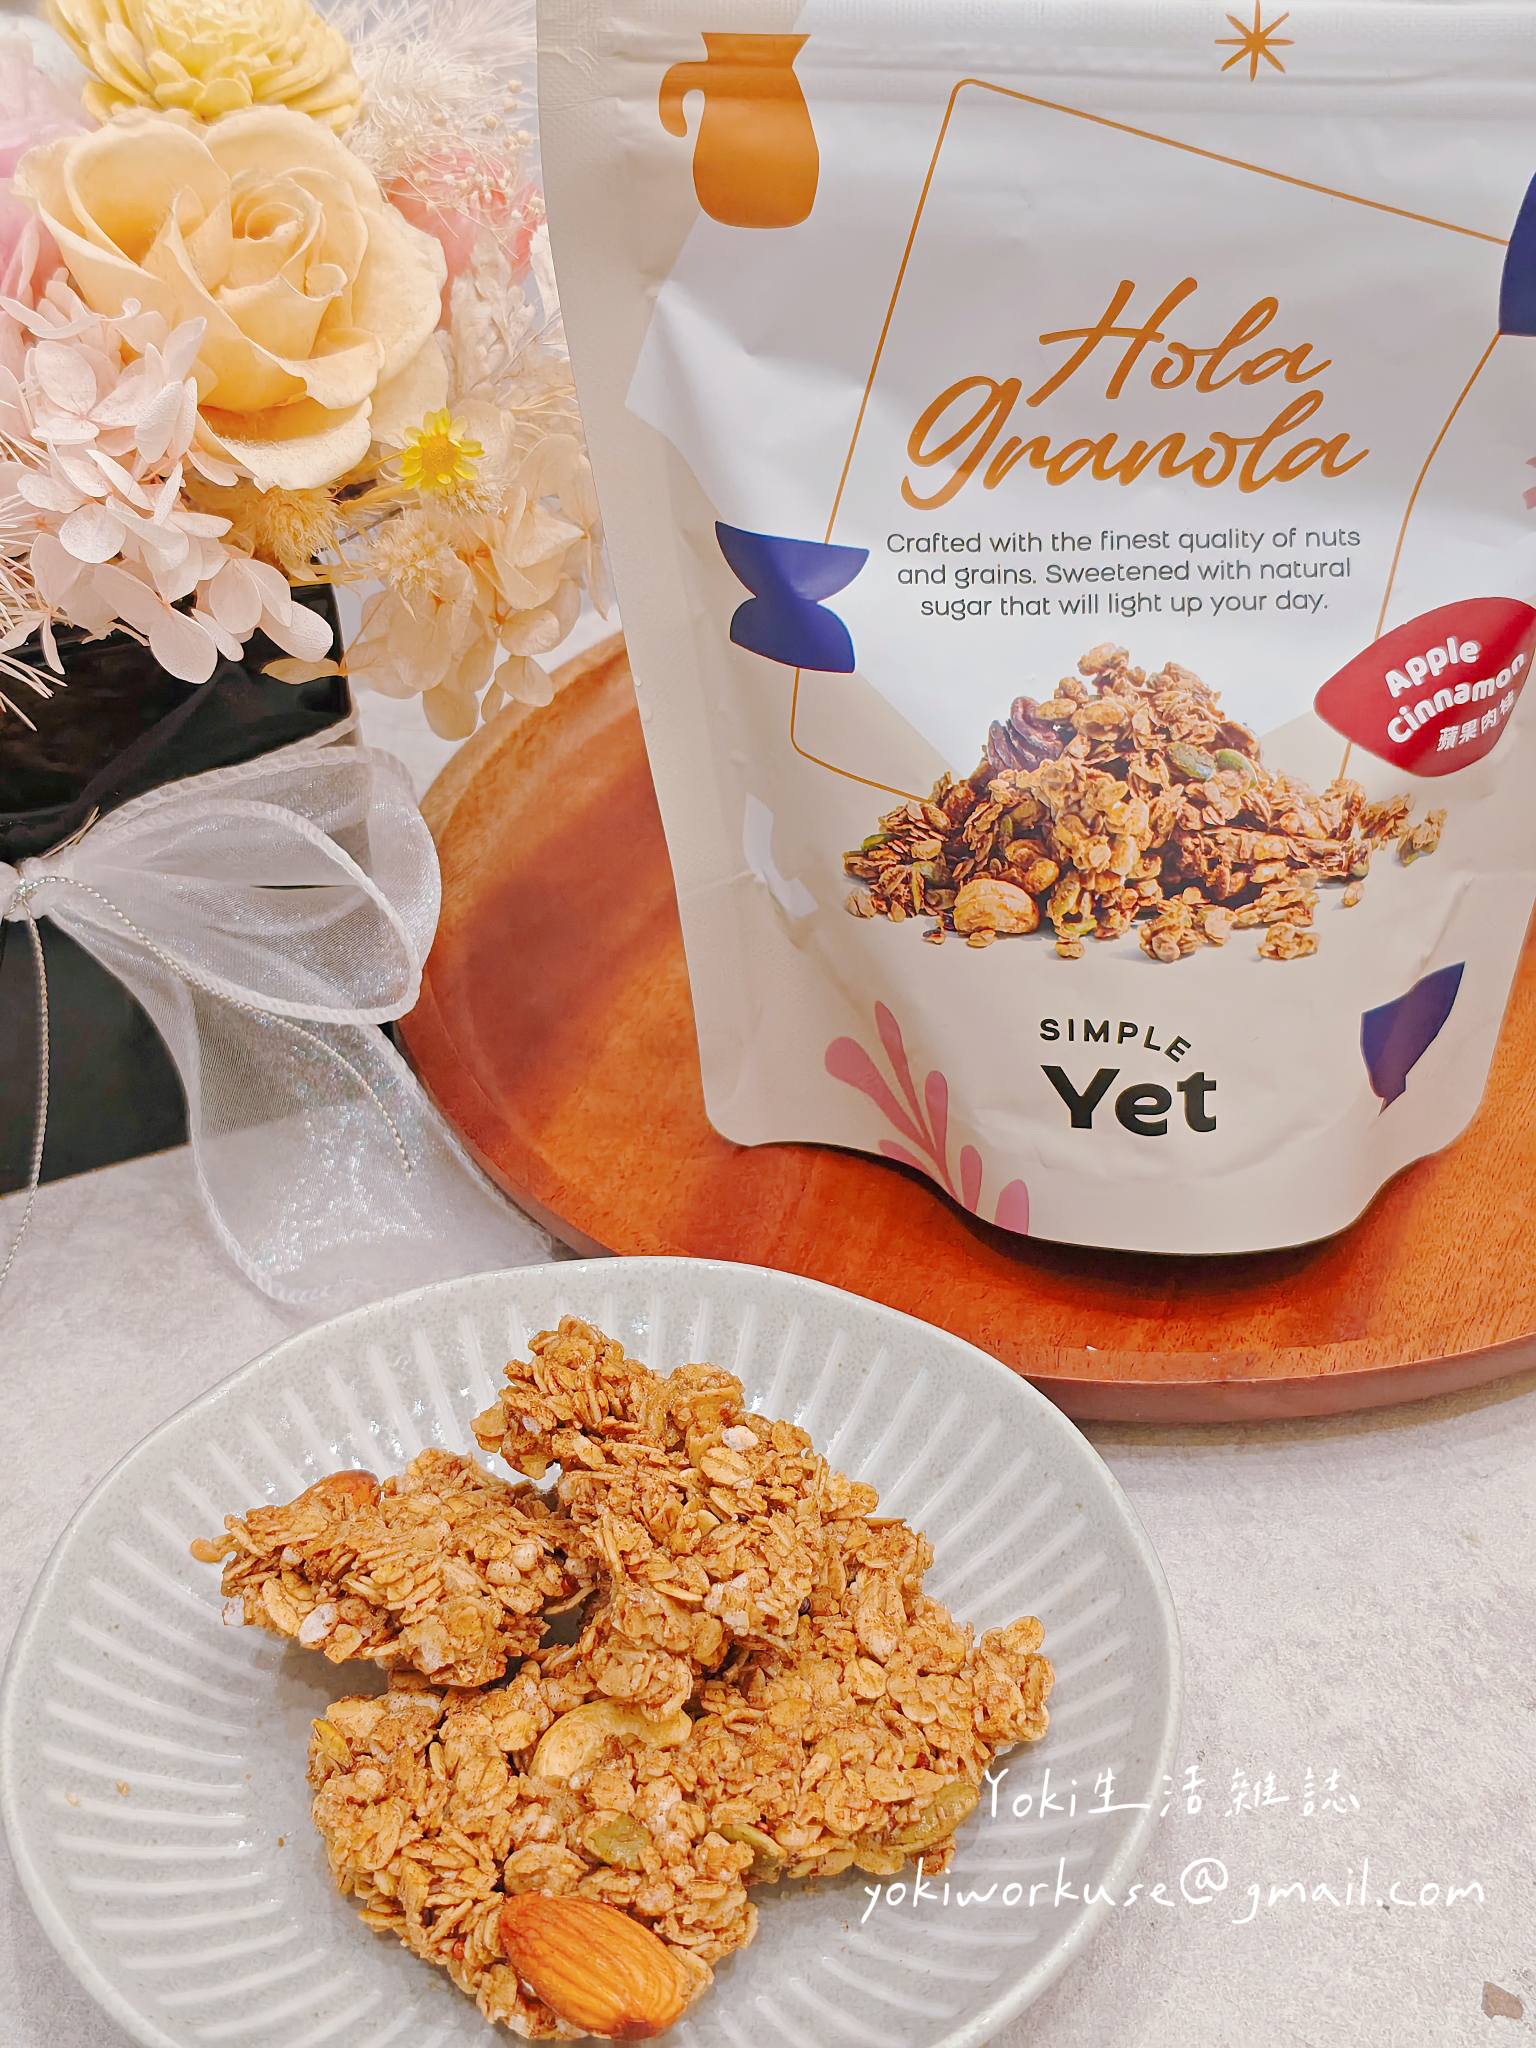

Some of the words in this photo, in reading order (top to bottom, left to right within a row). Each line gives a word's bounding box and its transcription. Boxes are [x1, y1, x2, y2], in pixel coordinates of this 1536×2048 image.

[1026, 277, 1332, 408] Hola
[887, 532, 981, 553] Crafted
[989, 531, 1042, 553] with
[1051, 531, 1092, 552] the
[1100, 530, 1170, 550] finest
[1178, 528, 1265, 553] quality
[1272, 528, 1297, 548] of
[1305, 528, 1361, 548] nuts
[897, 564, 946, 585] and
[954, 564, 1037, 590] grains.
[1045, 560, 1190, 584] Sweetened
[1197, 560, 1251, 581] with
[1260, 557, 1351, 579] natural
[920, 598, 993, 621] sugar
[1000, 595, 1051, 616] that
[1058, 594, 1099, 615] will
[1108, 592, 1162, 618] light
[1170, 596, 1203, 617] up
[1210, 595, 1267, 617] your
[1275, 590, 1328, 617] day.
[1384, 635, 1482, 698] Apple
[1387, 653, 1526, 744] Cinnamon
[1039, 1018, 1192, 1063] SIMPLE
[1039, 1064, 1217, 1137] Yet
